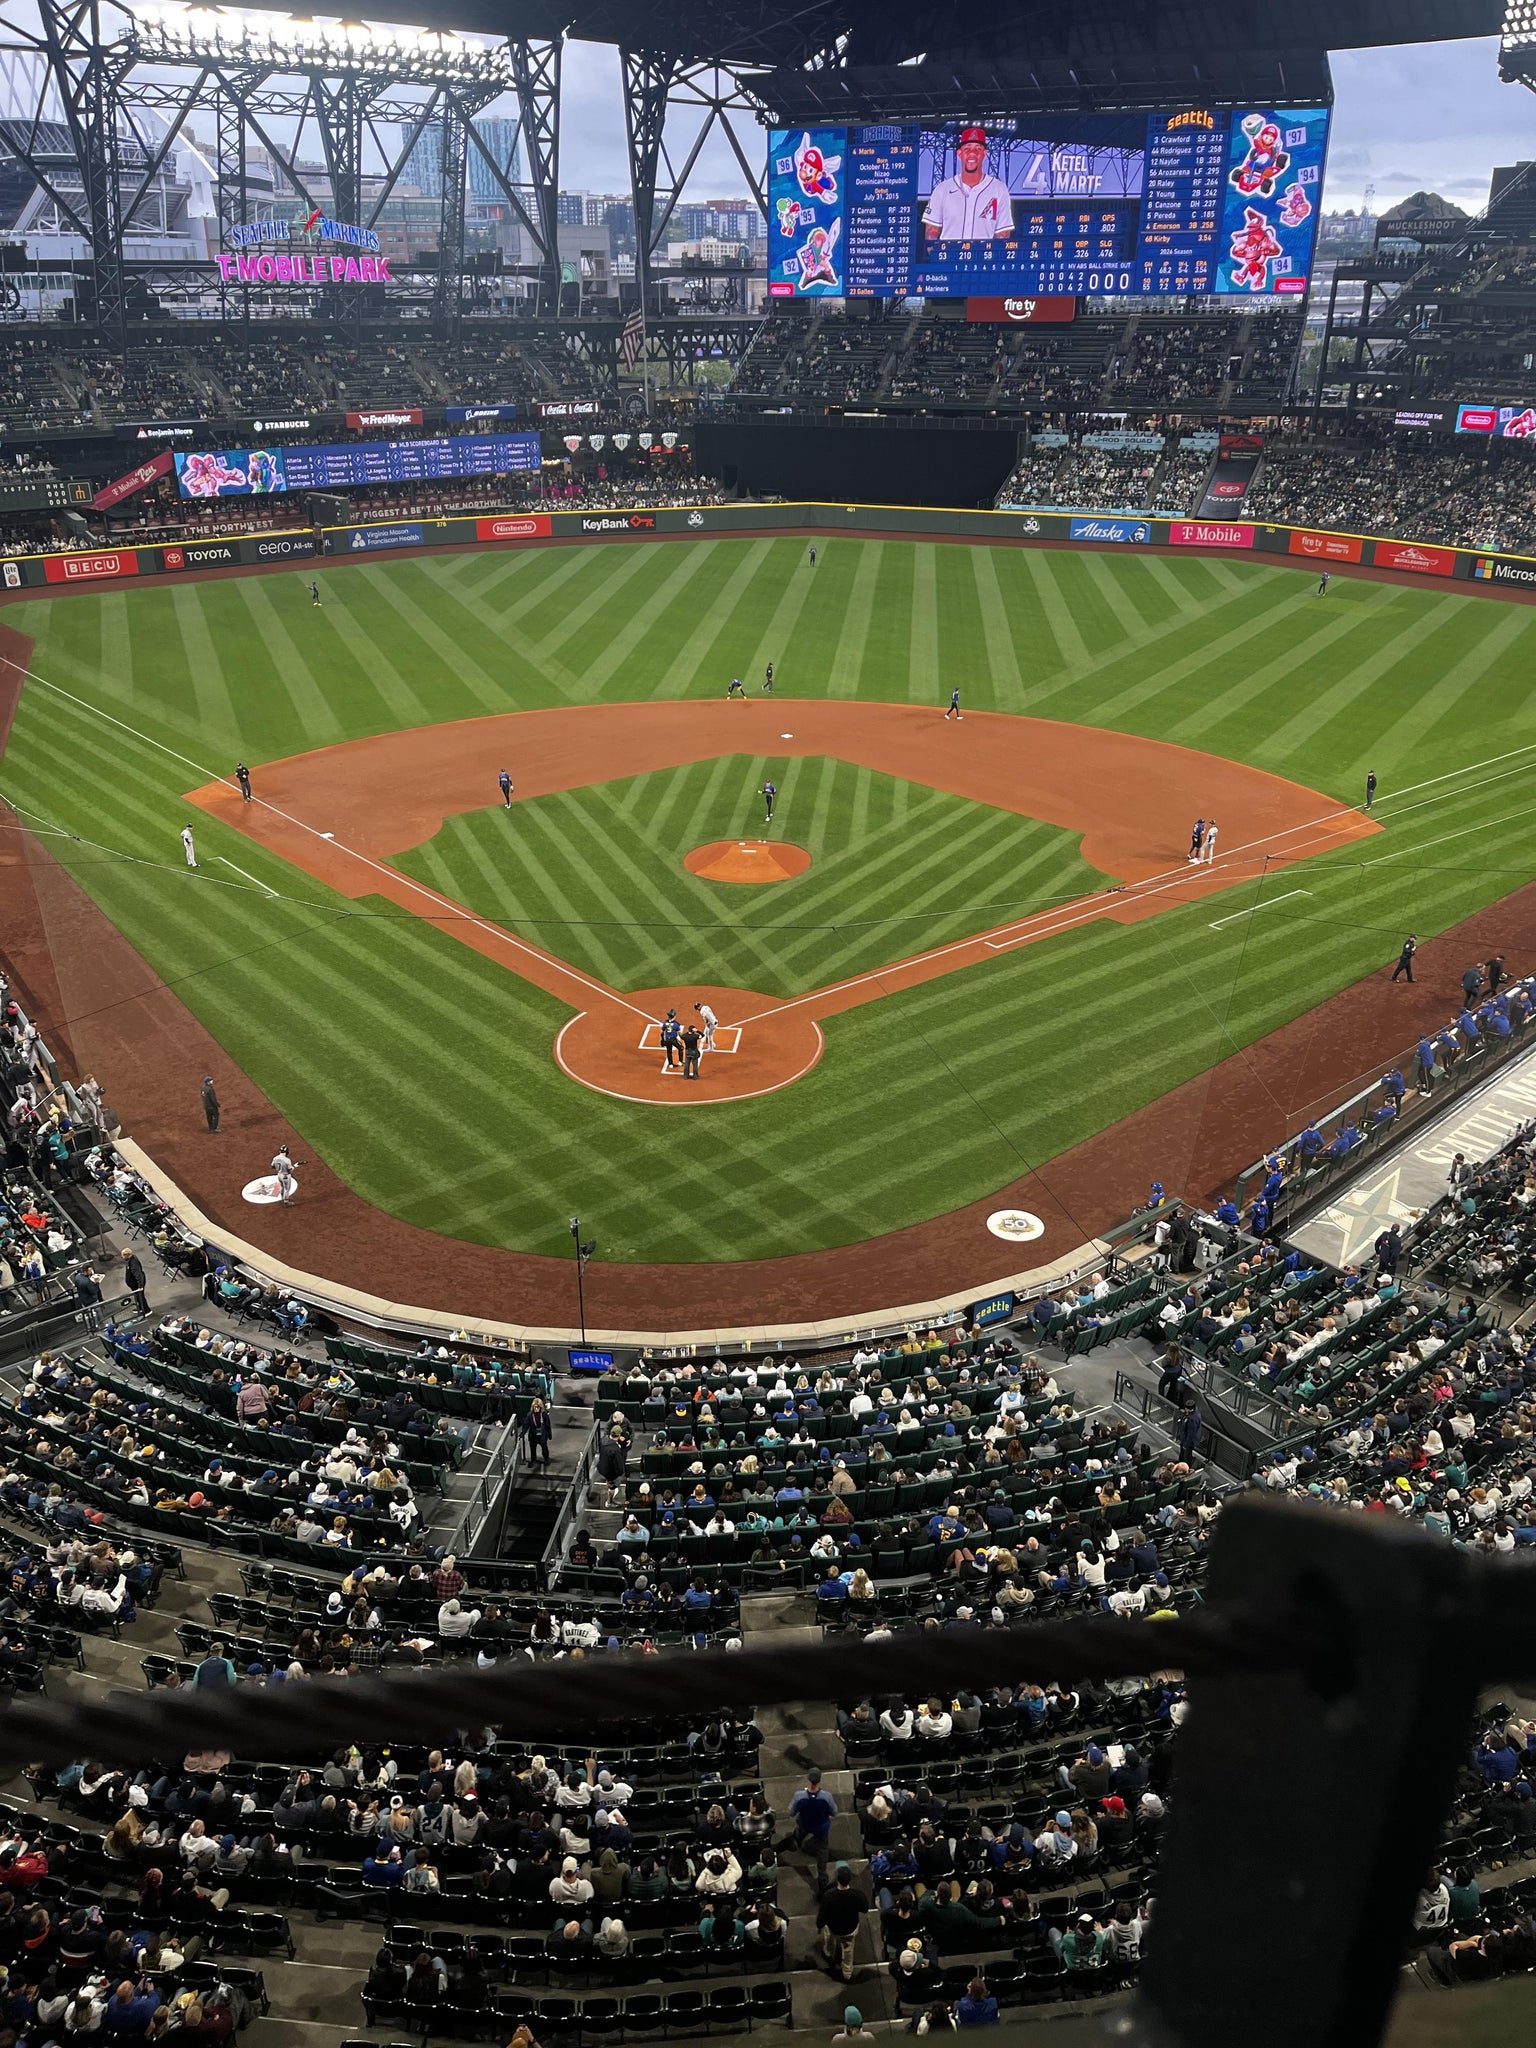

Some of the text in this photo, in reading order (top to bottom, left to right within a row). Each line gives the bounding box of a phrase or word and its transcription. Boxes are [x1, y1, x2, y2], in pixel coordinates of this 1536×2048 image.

[1166, 110, 1214, 131] seattle
[1209, 134, 1223, 142] .212
[901, 146, 913, 154] .276
[1052, 152, 1087, 172] KETEL
[1160, 158, 1180, 166] Naylor
[1023, 154, 1047, 194] 4
[1056, 172, 1102, 193] MARTE
[1102, 214, 1115, 222] OPS
[1029, 226, 1043, 234] .276
[1100, 224, 1115, 232] .802
[1388, 221, 1456, 230] MUCKLESHOOT
[231, 218, 380, 251] SEATTLE MARINERS
[959, 252, 971, 260] 210
[984, 251, 992, 259] 58
[1007, 251, 1015, 259] 22
[1030, 250, 1038, 259] 34
[1054, 250, 1062, 258] 16
[1074, 250, 1089, 258] .326
[1098, 249, 1113, 257] .476
[215, 255, 392, 282] T-MOBILE PARK
[1089, 273, 1129, 290] 0 0 0
[1004, 299, 1036, 311] fire tv
[546, 403, 594, 415] Coca-Cola Coca-Cola
[264, 421, 309, 429] STARBUCKS
[148, 427, 193, 437] Benjamin Moore
[410, 439, 439, 447] SCOREBOARD
[594, 440, 601, 448] 24
[118, 478, 138, 493] Mobile
[497, 524, 533, 533] Nintendo
[583, 518, 629, 531] KeyBank
[1026, 520, 1038, 529] 50
[189, 526, 210, 535] THE
[367, 528, 409, 539] Virginia Mason
[1074, 523, 1124, 539] Alaska
[1181, 526, 1241, 542] T Mobile
[368, 537, 399, 545] Franciscan
[1302, 536, 1323, 547] fire tv
[259, 541, 290, 555] eero
[187, 549, 231, 562] TOYOTA
[1393, 558, 1430, 567] MUCKLESHOOT
[1004, 1219, 1028, 1229] 50
[975, 1301, 1010, 1321] seattle
[573, 1354, 610, 1367] seattle
[422, 1817, 443, 1832] 24
[1426, 1907, 1446, 1923] 44
